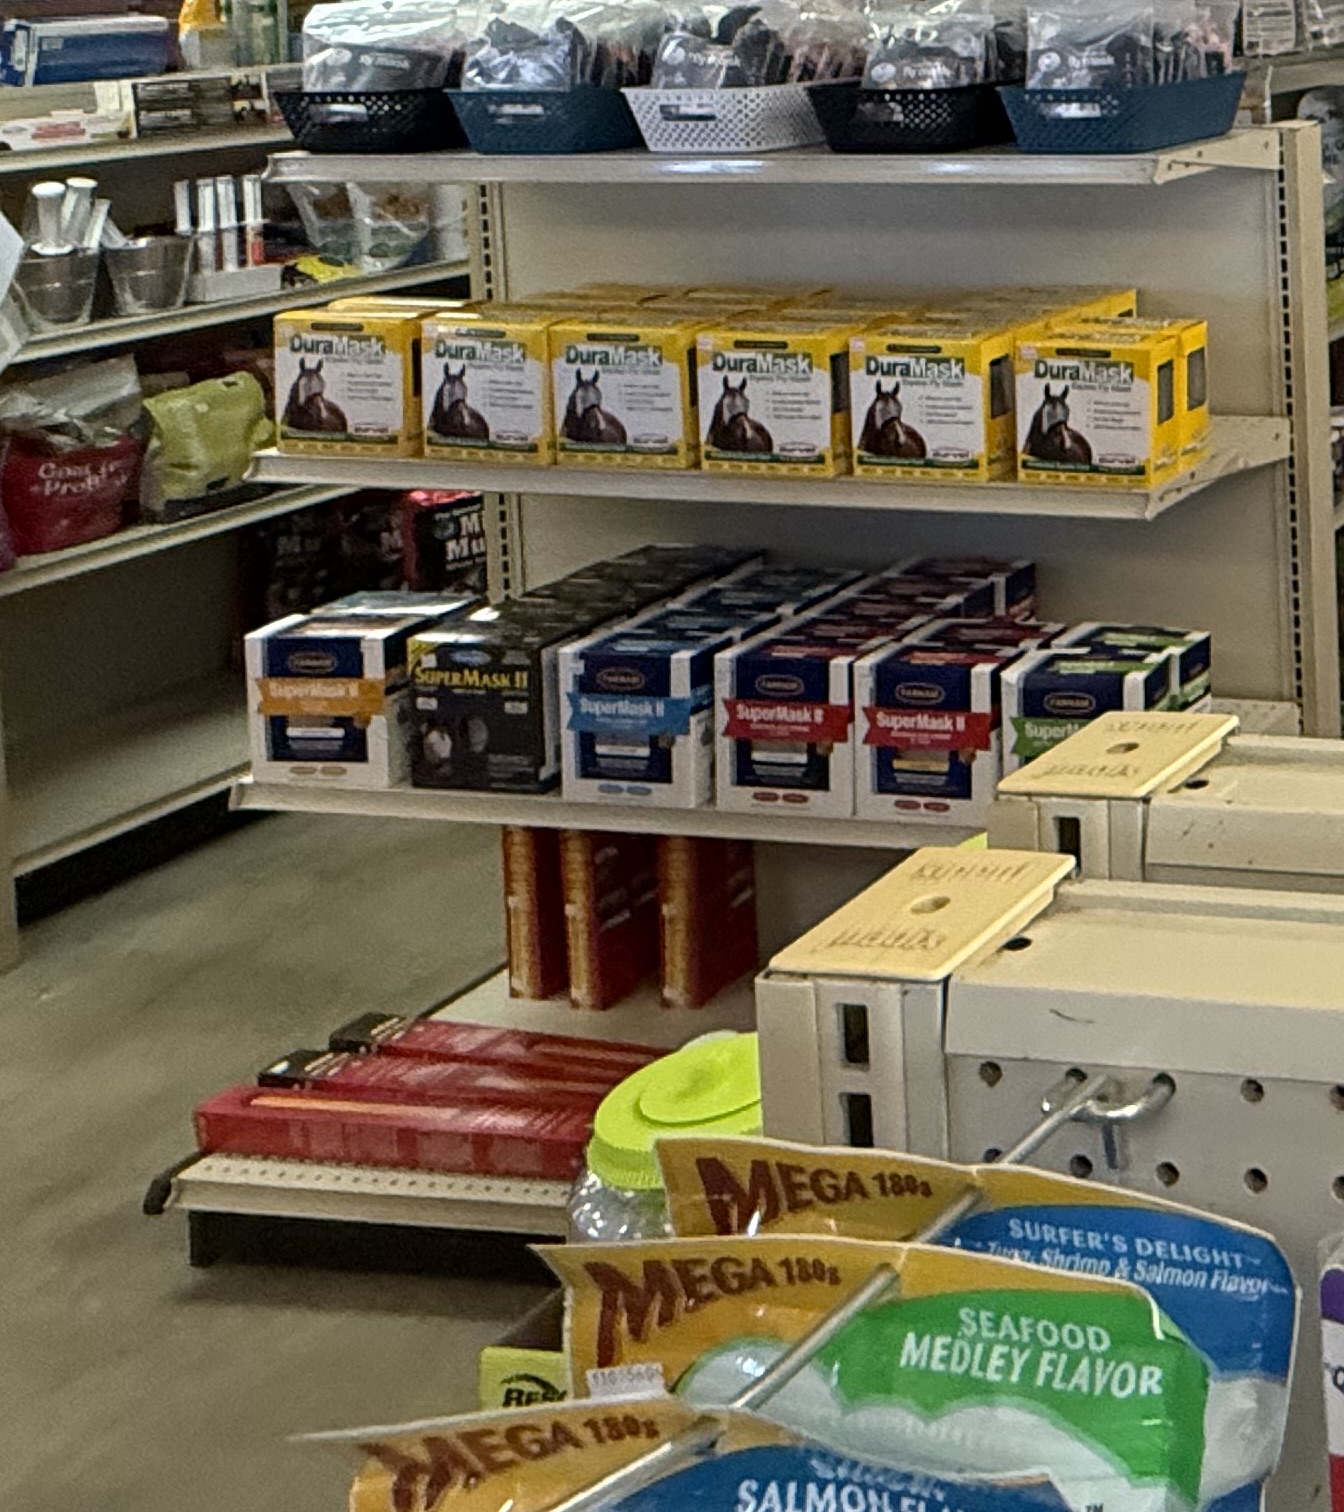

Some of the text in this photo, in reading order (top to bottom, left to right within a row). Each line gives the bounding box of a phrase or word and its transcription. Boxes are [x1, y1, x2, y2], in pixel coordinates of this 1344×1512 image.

[289, 335, 386, 357] DuraMask
[435, 339, 527, 365] DuraMask
[565, 344, 663, 368] DuraMask
[712, 351, 814, 374] DuraMask
[865, 355, 966, 379] DuraMask
[1032, 358, 1135, 385] DuraMask
[579, 697, 654, 717] SuperMask
[735, 703, 812, 724] SuperMask
[875, 711, 966, 732] SuperMask II
[694, 1156, 871, 1236] MEGA
[1008, 1217, 1245, 1270] SURFER'S DELIGHT
[1114, 1256, 1132, 1281] &
[1132, 1260, 1209, 1288] Salmon
[1209, 1267, 1269, 1296] Flavor
[583, 1255, 778, 1369] MEGA
[957, 1306, 1112, 1353] SEAFOOD
[899, 1331, 1164, 1400] MEDLEY FLAVOR
[357, 1420, 585, 1512] MEGA
[735, 1478, 893, 1512] SALMON
